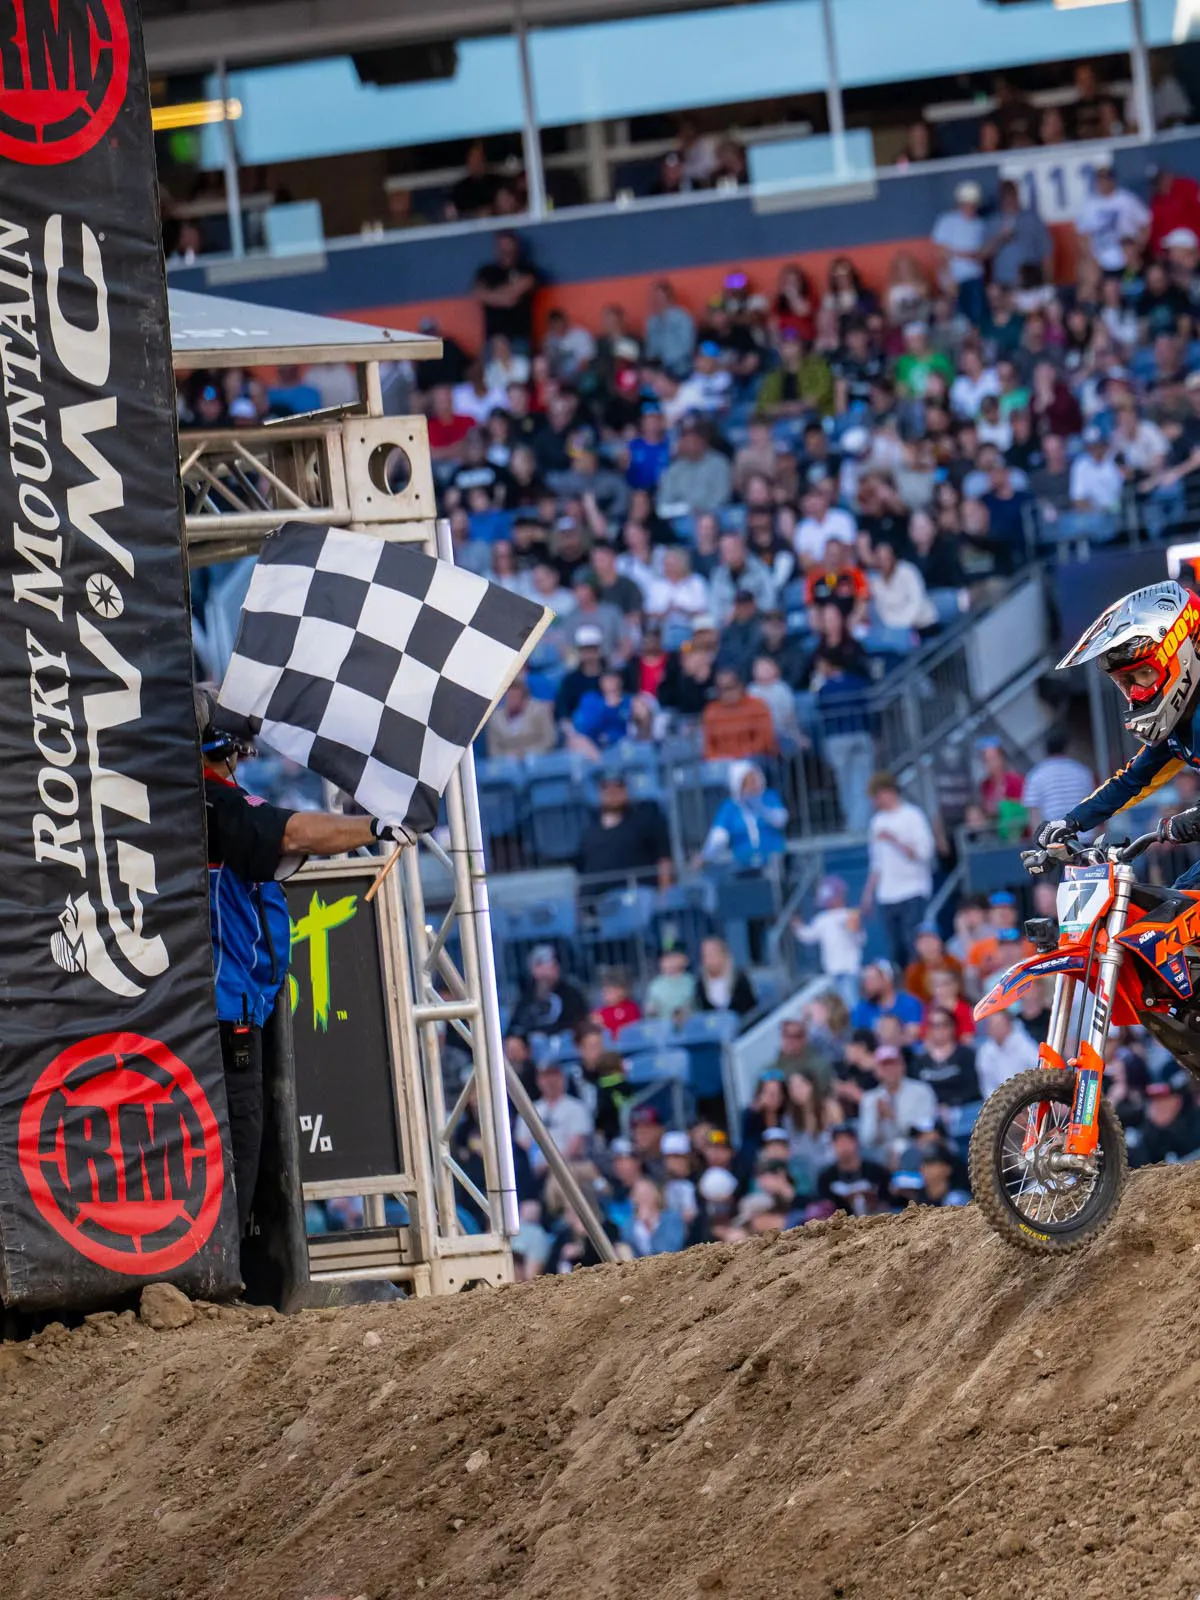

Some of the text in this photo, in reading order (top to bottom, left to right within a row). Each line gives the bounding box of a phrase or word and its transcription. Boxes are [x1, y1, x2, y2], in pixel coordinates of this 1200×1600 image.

[0, 217, 87, 878] ROCKY MOUNTAIN
[1154, 604, 1200, 667] 100%
[1171, 669, 1193, 712] FLY
[1062, 882, 1099, 922] 7
[1138, 929, 1156, 945] KTM
[1075, 1079, 1085, 1118] DUNLOP
[1018, 1223, 1048, 1241] DUNLOP
